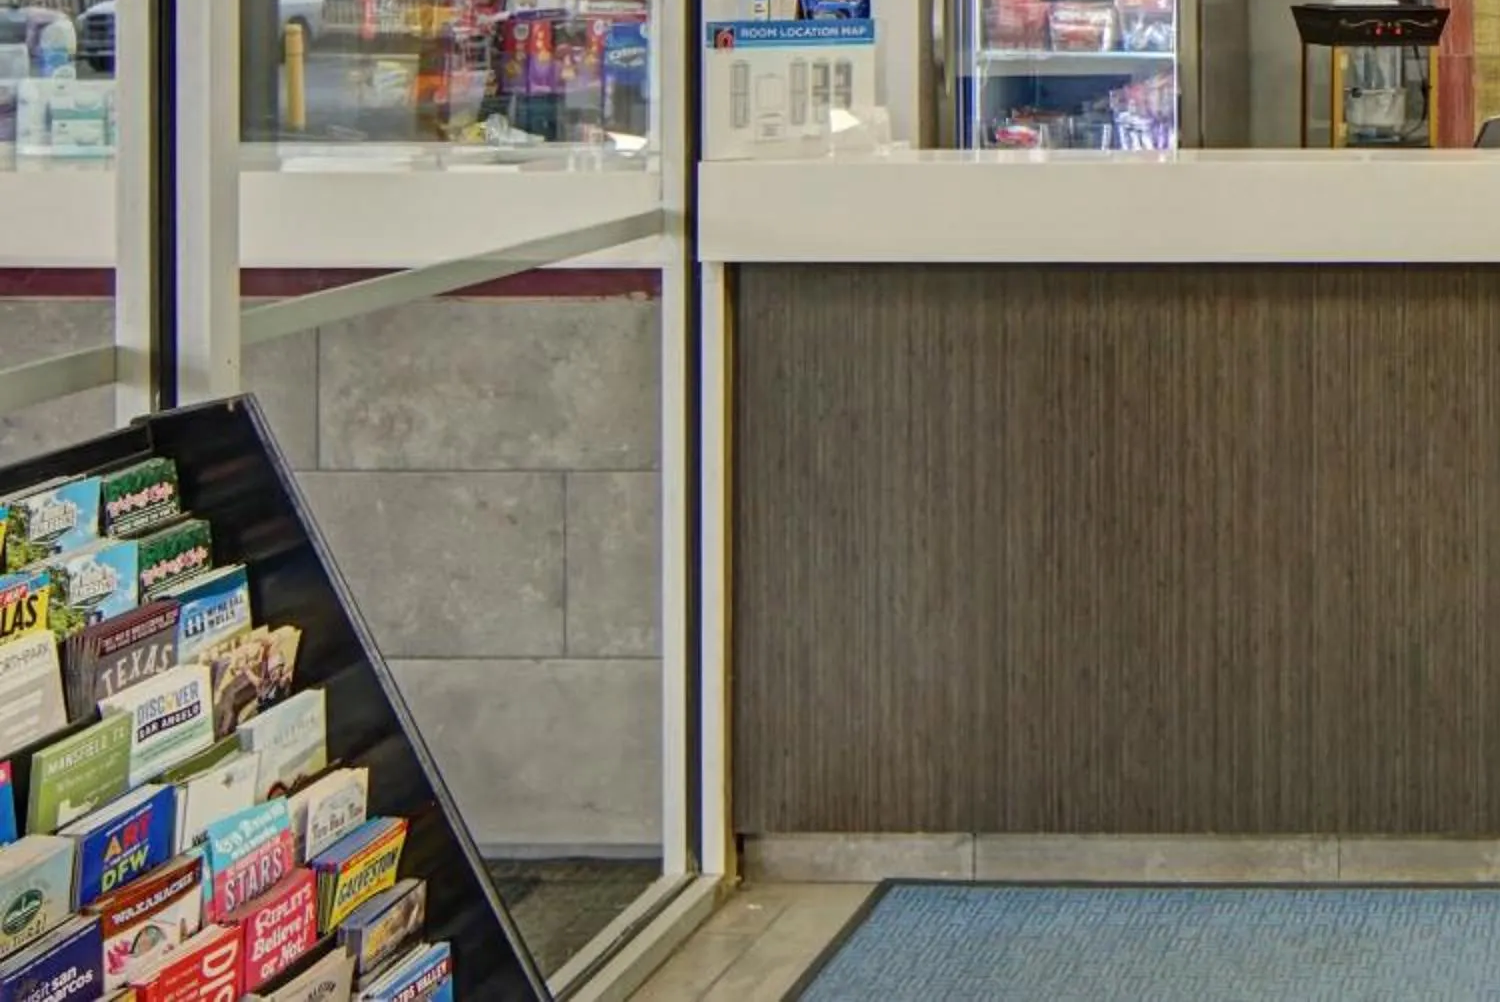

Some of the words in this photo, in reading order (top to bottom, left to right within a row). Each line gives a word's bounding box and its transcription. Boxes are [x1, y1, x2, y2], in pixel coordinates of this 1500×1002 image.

[740, 27, 778, 38] ROOM
[780, 26, 840, 37] LOCATION
[841, 25, 868, 36] MAP
[101, 644, 174, 698] TEXAS
[139, 720, 160, 740] SAN
[161, 703, 200, 729] ANGELO
[104, 808, 154, 865] ART
[101, 845, 151, 893] DFW
[225, 846, 284, 914] STARS
[252, 915, 303, 963] Believe
[51, 965, 77, 992] san
